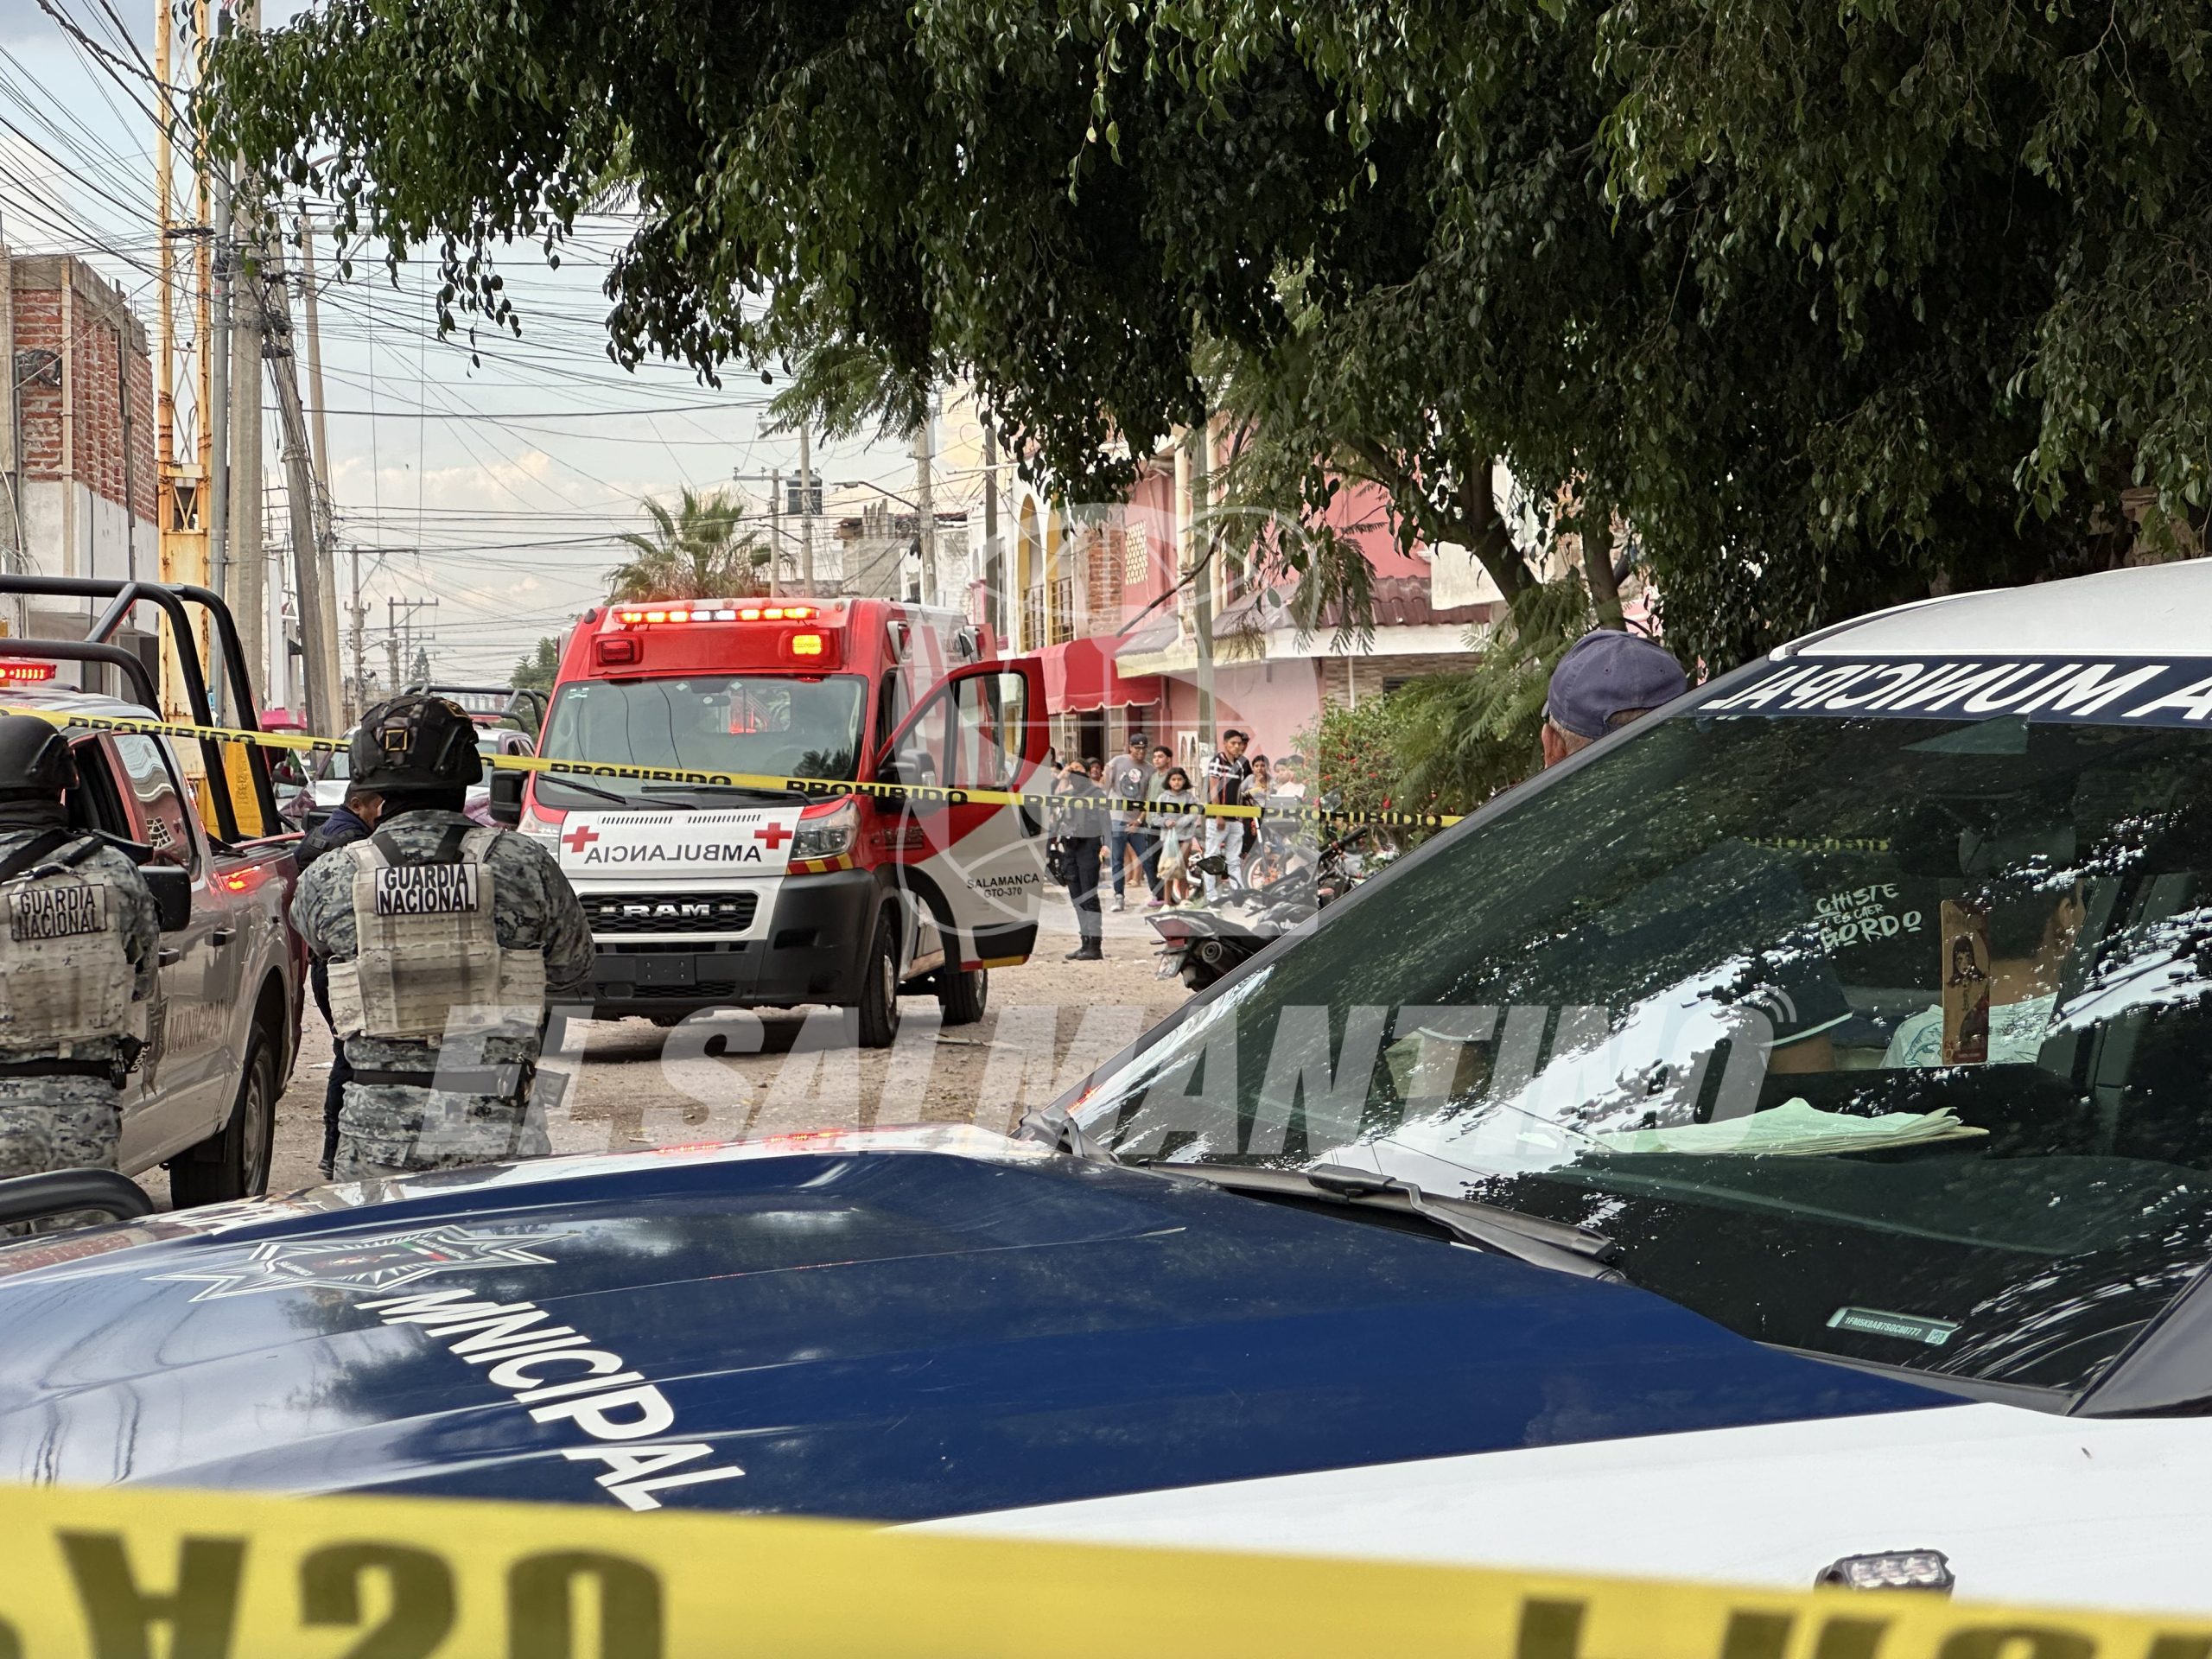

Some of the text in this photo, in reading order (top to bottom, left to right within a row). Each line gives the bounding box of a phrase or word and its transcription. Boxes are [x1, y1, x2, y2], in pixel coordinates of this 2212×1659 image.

[68, 716, 257, 745] PROHIBIDO
[550, 762, 733, 786] PROHIBIDO
[785, 780, 969, 804] PROHIBIDO
[1023, 794, 1205, 815] PROHIBIDO
[1261, 807, 1442, 827] PROHIBIDO
[384, 862, 469, 891] GUARDIA
[967, 872, 1040, 890] SALAMANCA
[19, 886, 97, 916] GUARDIA
[379, 880, 475, 914] NACIONAL
[983, 887, 1023, 899] GTO-370
[623, 904, 711, 918] RAM
[17, 908, 102, 940] NACIONAL
[1820, 910, 1923, 949] GORDO
